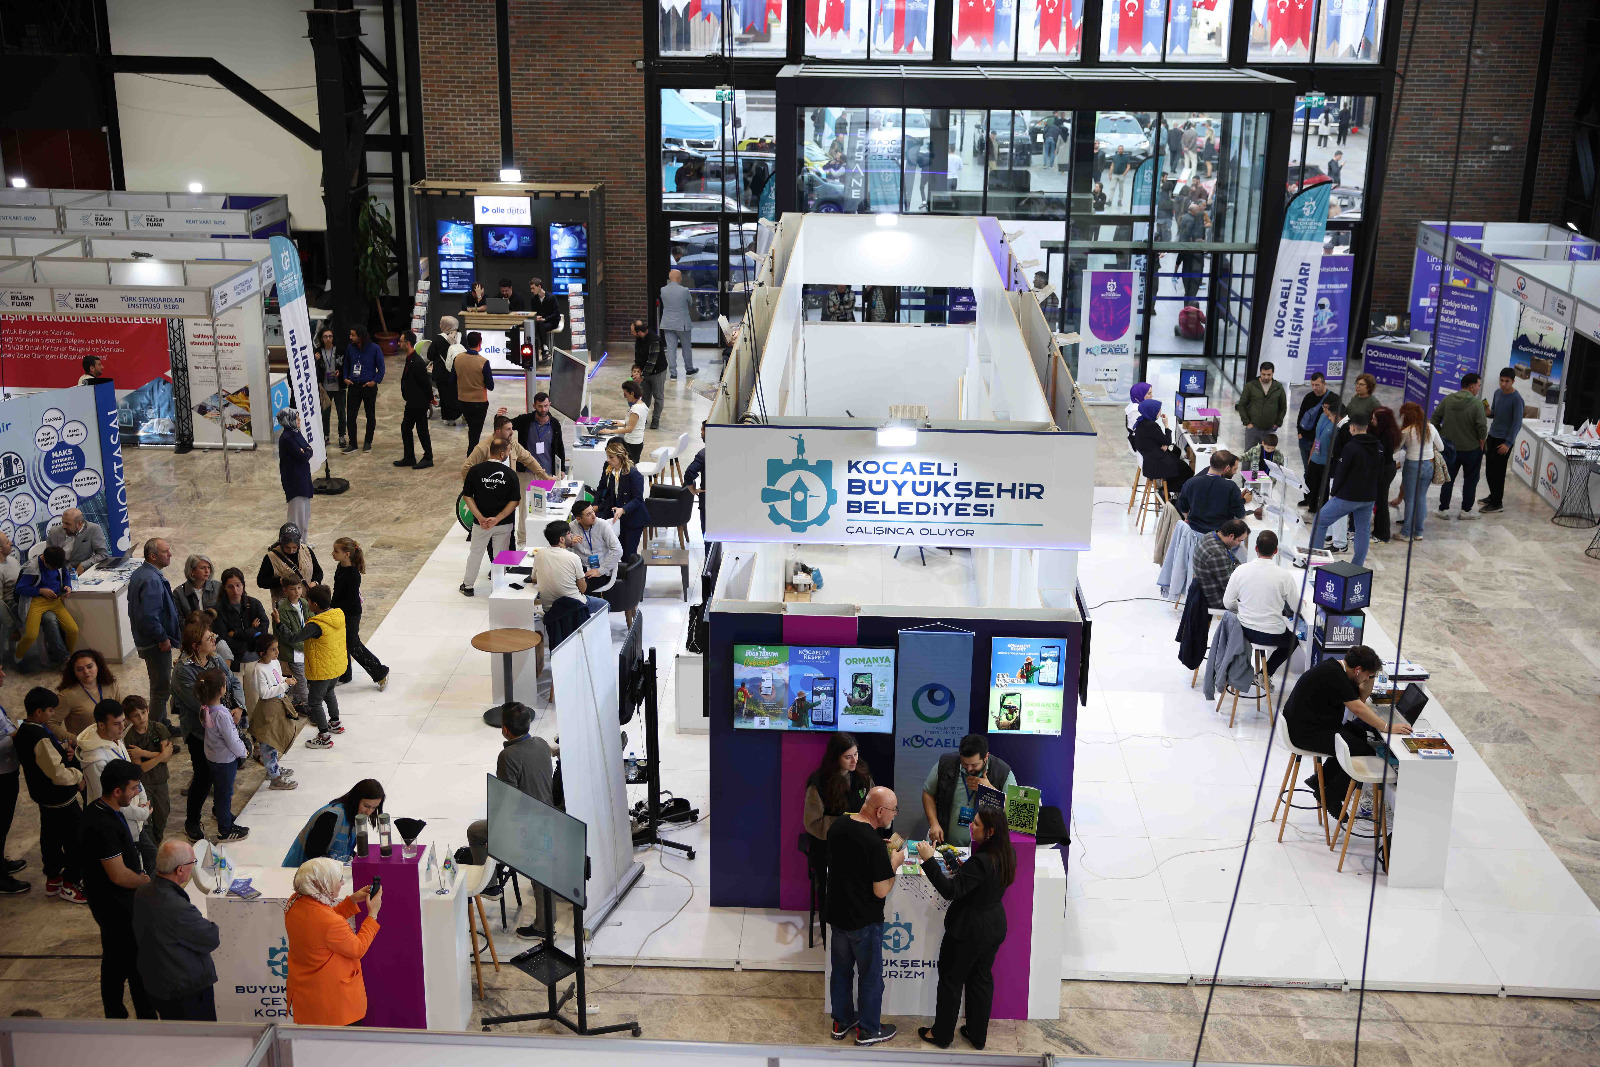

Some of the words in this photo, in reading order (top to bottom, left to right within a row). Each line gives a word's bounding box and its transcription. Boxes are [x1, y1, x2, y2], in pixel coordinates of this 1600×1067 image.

[491, 206, 505, 214] alle
[1273, 278, 1293, 338] KOCAELİ
[1287, 309, 1305, 359] BİLİŞİM
[1296, 262, 1311, 307] FUARI
[51, 448, 73, 459] MAKS
[847, 460, 958, 477] KOCAELİ
[847, 478, 1045, 501] BÜYÜKŞEHİR
[847, 500, 995, 518] BELEDİYESİ
[846, 526, 915, 536] ÇALIŞINCA
[919, 527, 975, 537] OLUYOR
[845, 656, 892, 665] ORMANYA
[902, 735, 963, 748] KOCAEL
